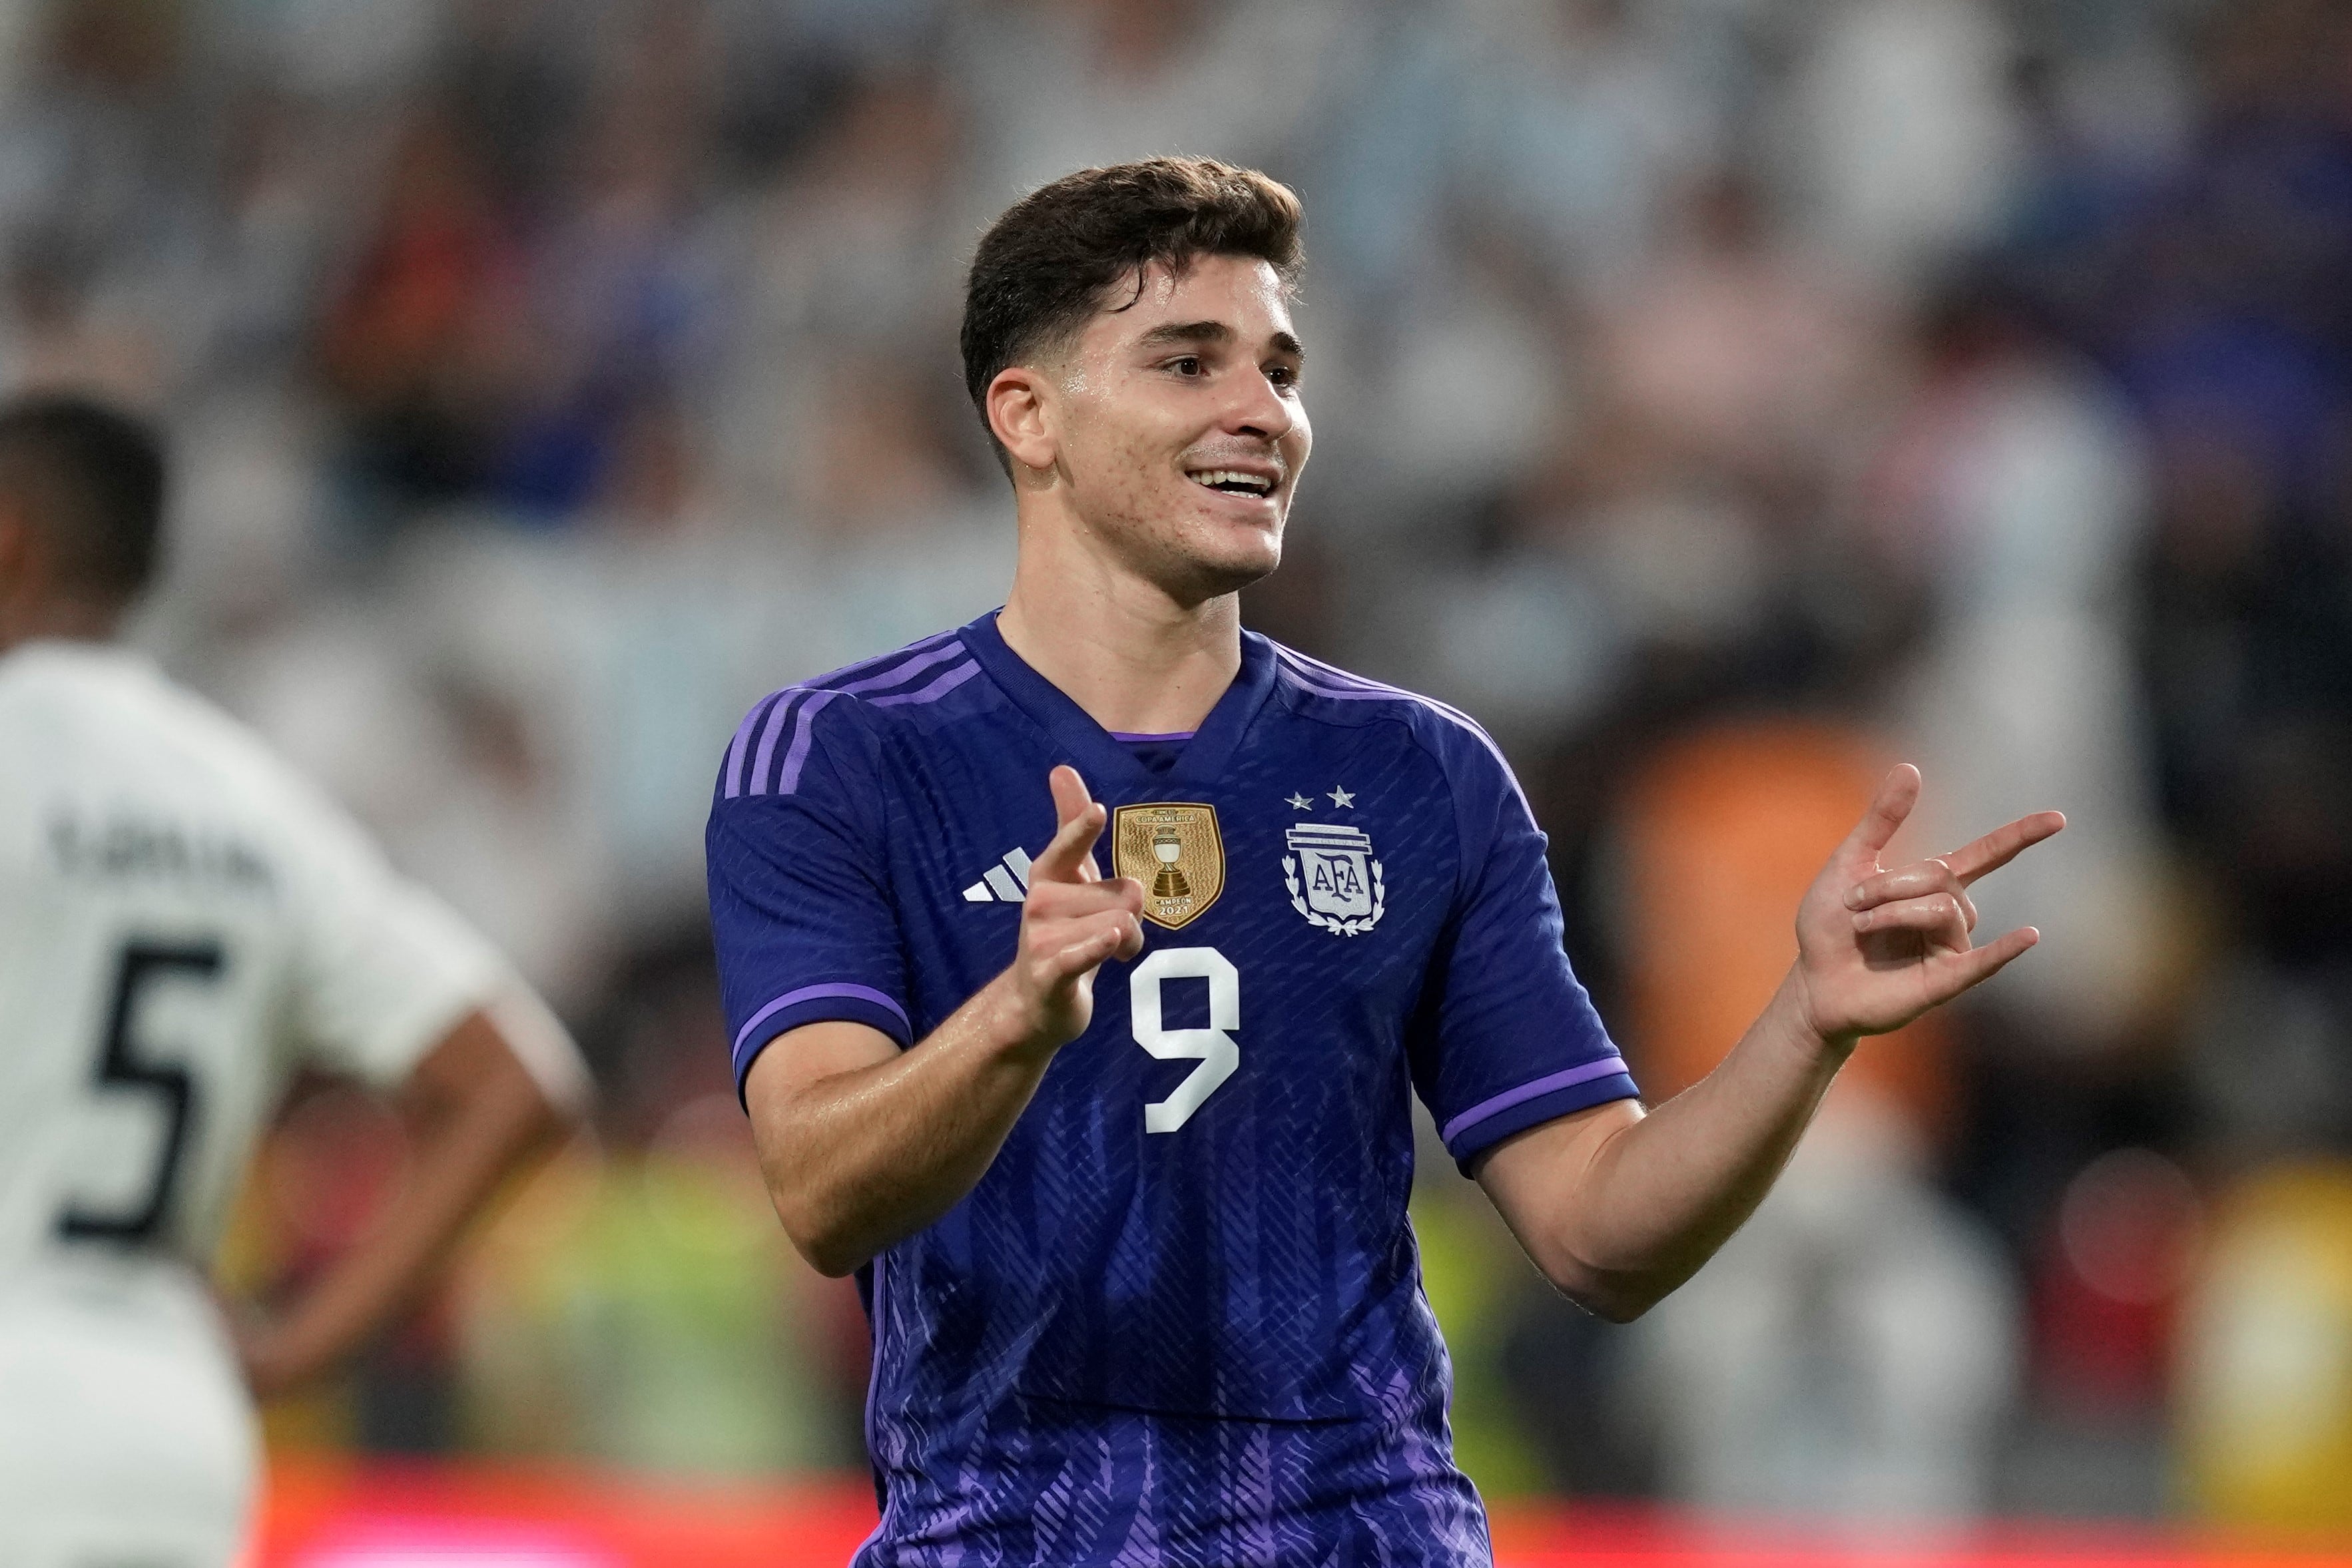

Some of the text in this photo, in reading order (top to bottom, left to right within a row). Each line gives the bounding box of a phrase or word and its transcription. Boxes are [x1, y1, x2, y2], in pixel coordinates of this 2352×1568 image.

[1159, 906, 1188, 915] 2021
[1313, 852, 1364, 902] AFA
[54, 935, 224, 1241] 5
[1130, 947, 1239, 1133] 9
